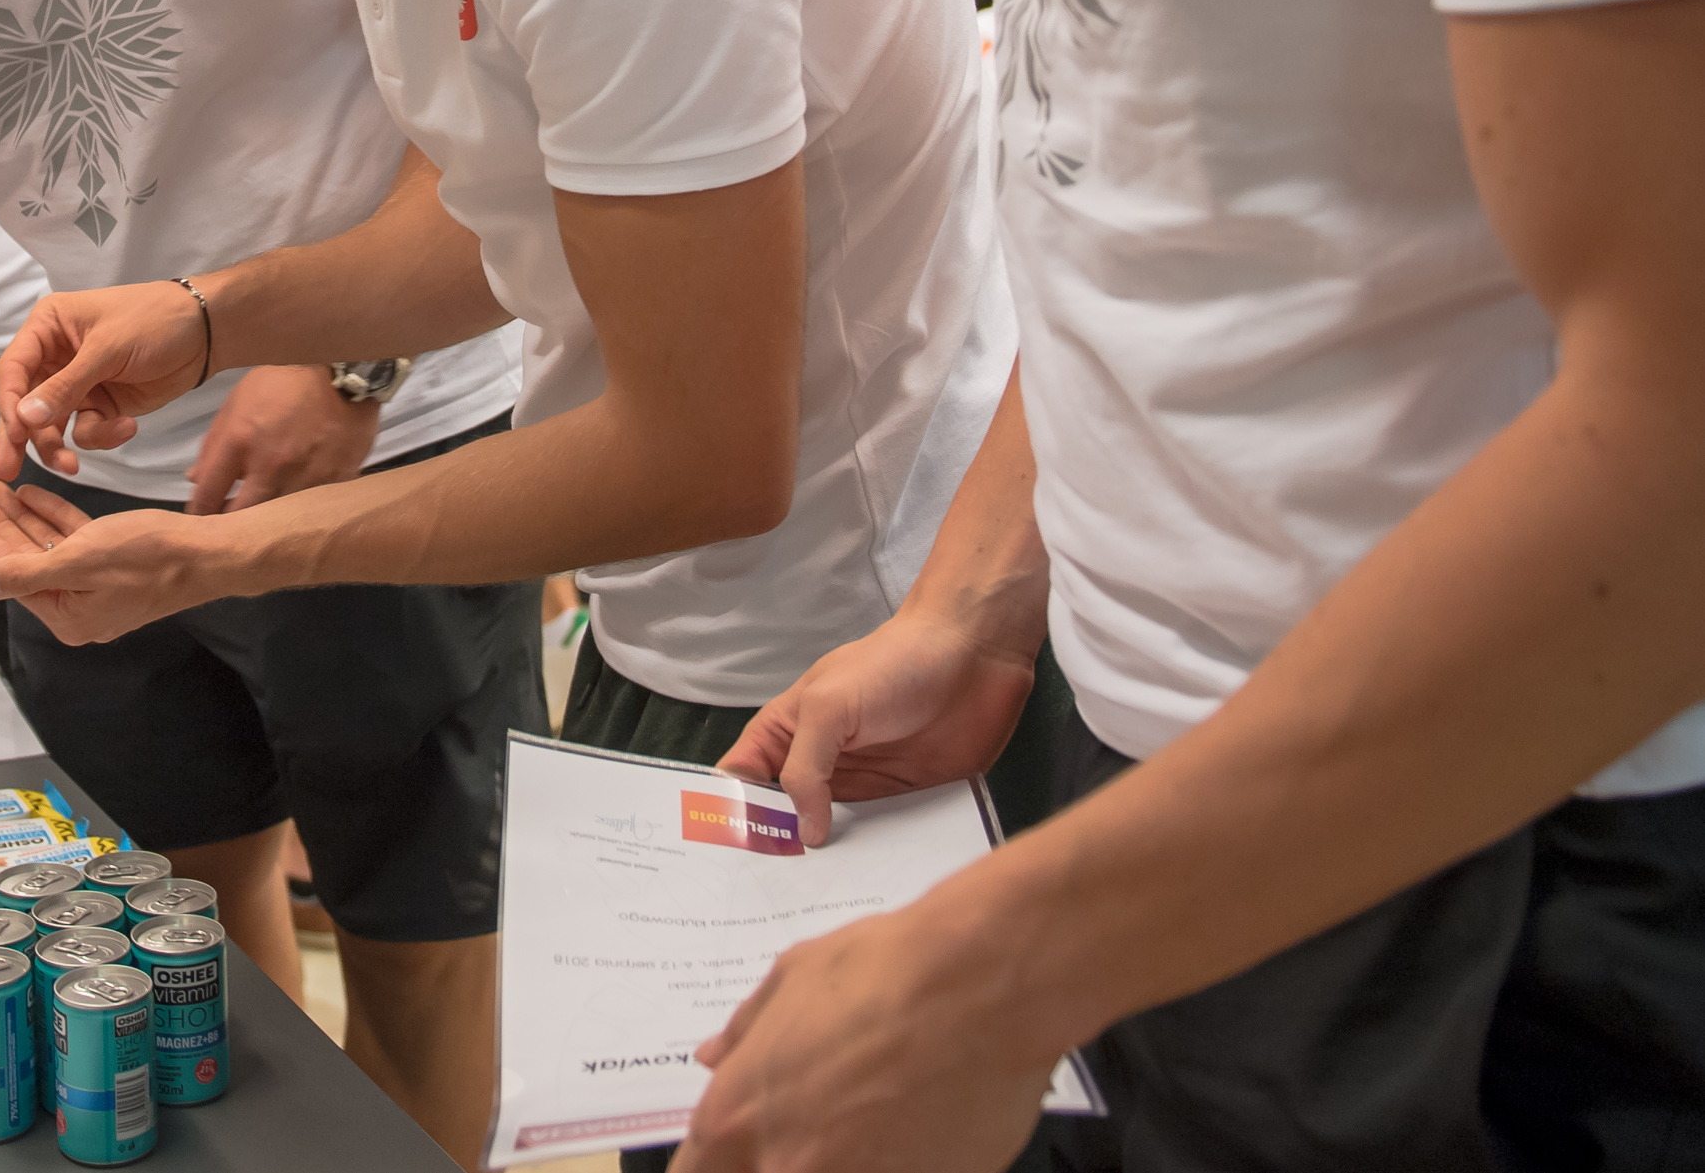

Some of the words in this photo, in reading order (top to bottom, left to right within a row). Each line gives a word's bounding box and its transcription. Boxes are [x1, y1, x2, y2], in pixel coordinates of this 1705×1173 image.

[617, 911, 708, 929] klubowego
[553, 953, 590, 968] 2018
[156, 964, 216, 985] OSHEE
[153, 981, 219, 1005] vitamin
[153, 1000, 221, 1029] SHOT
[155, 1029, 220, 1050] MAGNEZ+B6
[581, 1053, 690, 1075] kowiak
